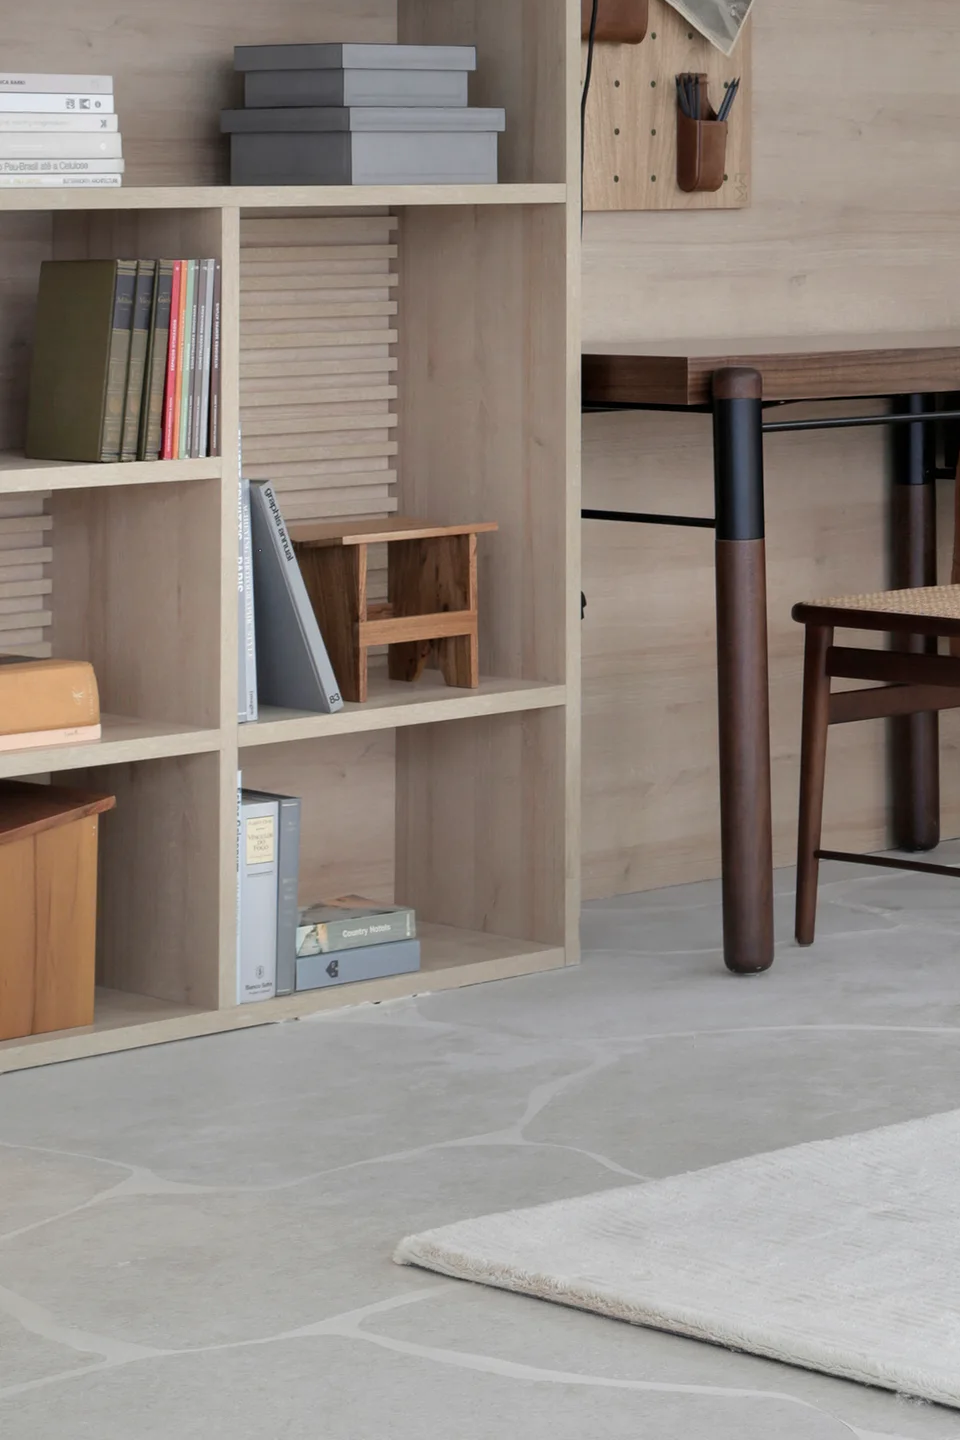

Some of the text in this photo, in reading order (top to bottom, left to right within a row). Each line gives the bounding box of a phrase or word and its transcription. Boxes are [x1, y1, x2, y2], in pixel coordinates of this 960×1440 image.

[4, 162, 38, 171] Pau-Brasil
[264, 488, 293, 562] graphis annual
[329, 693, 340, 704] 83
[342, 923, 391, 938] Country Hotels
